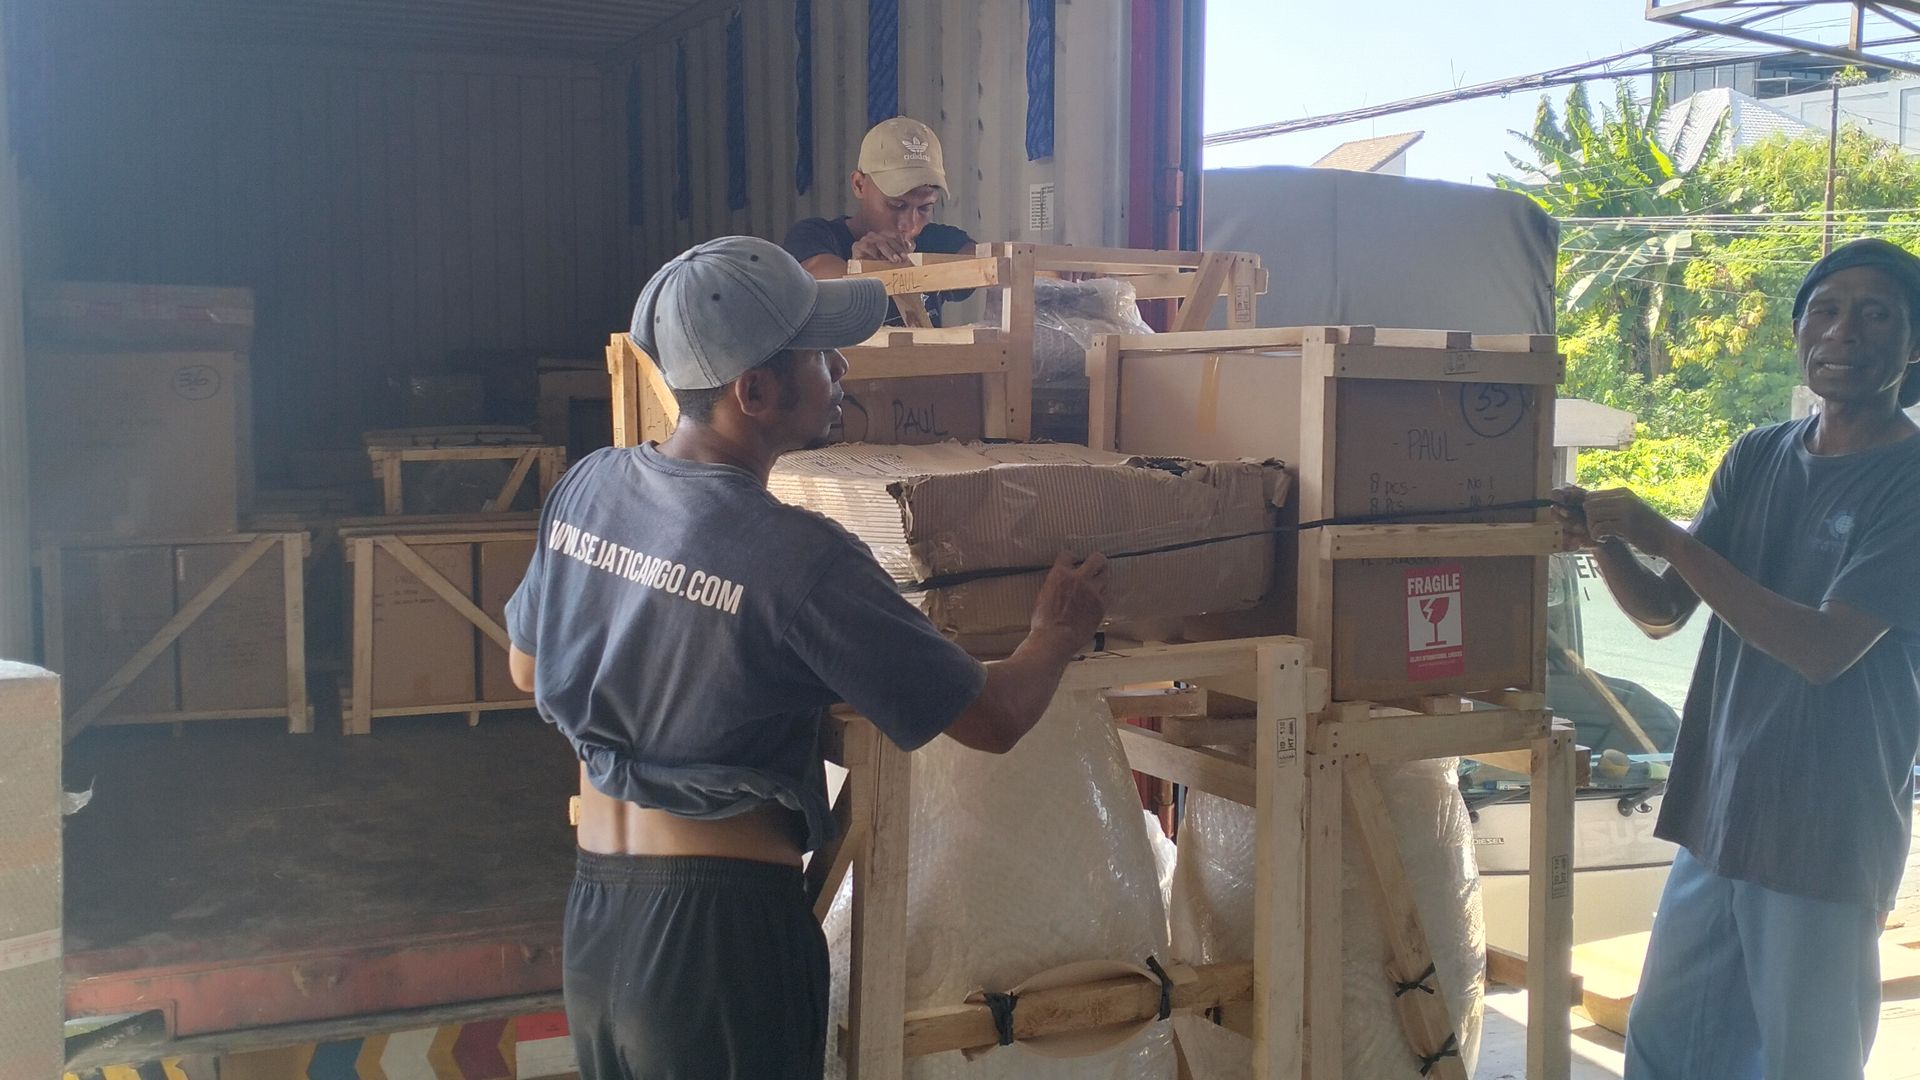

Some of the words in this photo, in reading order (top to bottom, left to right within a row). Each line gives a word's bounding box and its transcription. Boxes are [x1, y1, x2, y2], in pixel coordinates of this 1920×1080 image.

[892, 272, 920, 294] PAUL
[892, 400, 948, 441] PAUL
[1407, 428, 1459, 462] PAUL
[1407, 573, 1461, 595] FRAGILE
